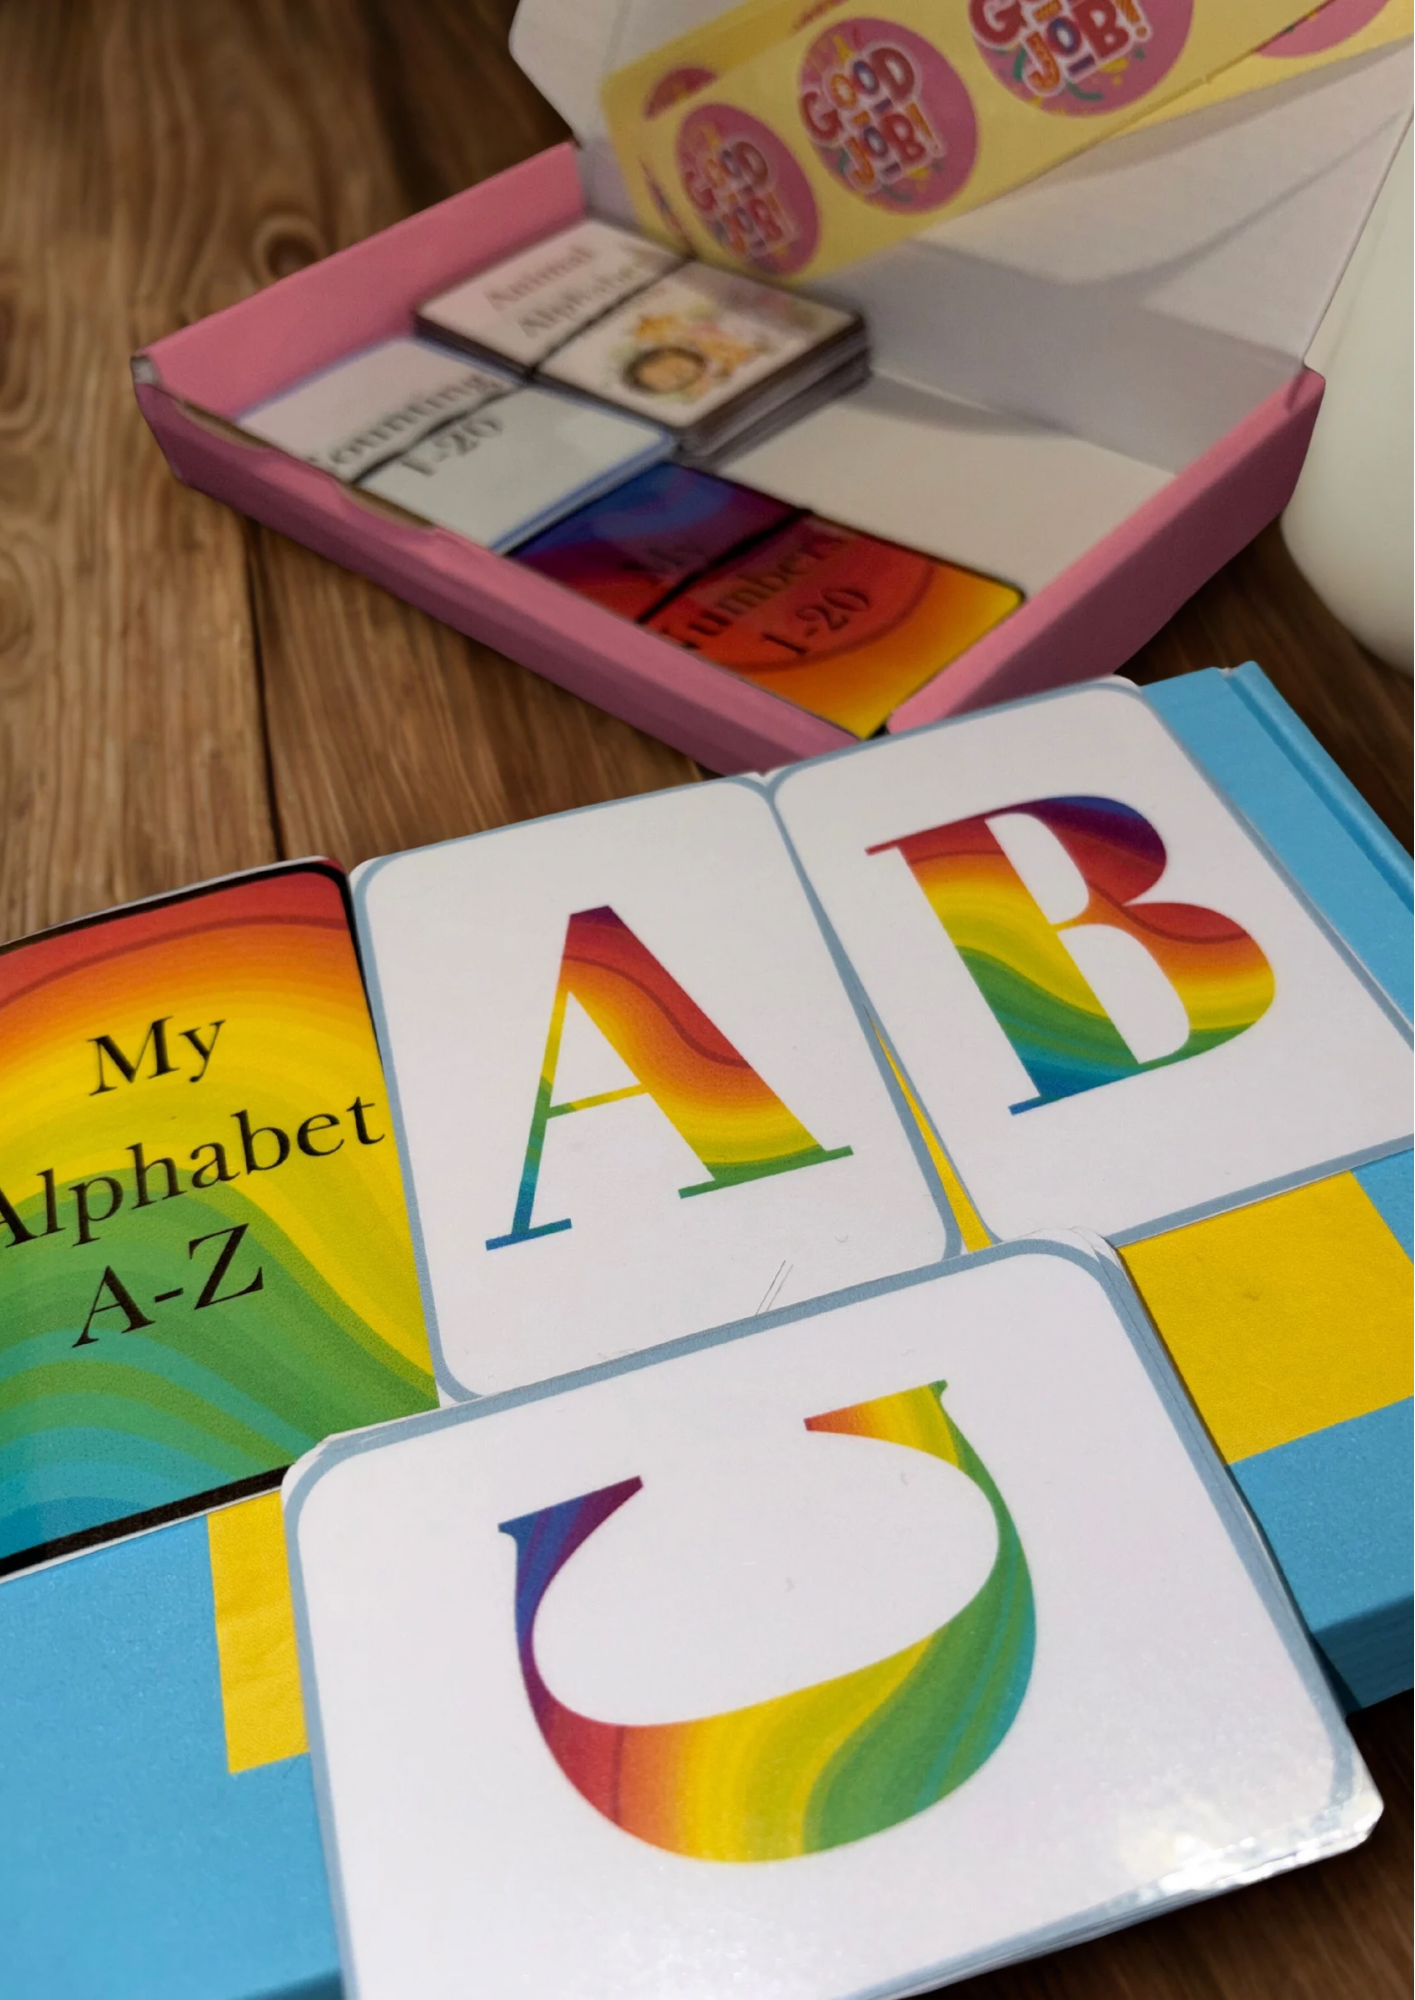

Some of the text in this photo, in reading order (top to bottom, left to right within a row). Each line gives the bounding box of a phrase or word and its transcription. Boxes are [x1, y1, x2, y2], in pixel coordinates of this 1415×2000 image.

[1024, 0, 1148, 91] JOB!
[802, 47, 915, 141] GOOD
[684, 140, 769, 212] GOOD
[846, 102, 940, 185] JOB!
[517, 264, 645, 339] Alphabe
[308, 372, 504, 466] ounting
[762, 587, 872, 655] 1-20
[865, 794, 1276, 1116] B
[86, 1015, 227, 1097] My
[485, 905, 854, 1252] A
[0, 1096, 386, 1249] Alphabet
[71, 1222, 264, 1348] A-Z
[497, 1379, 1037, 1862] C
